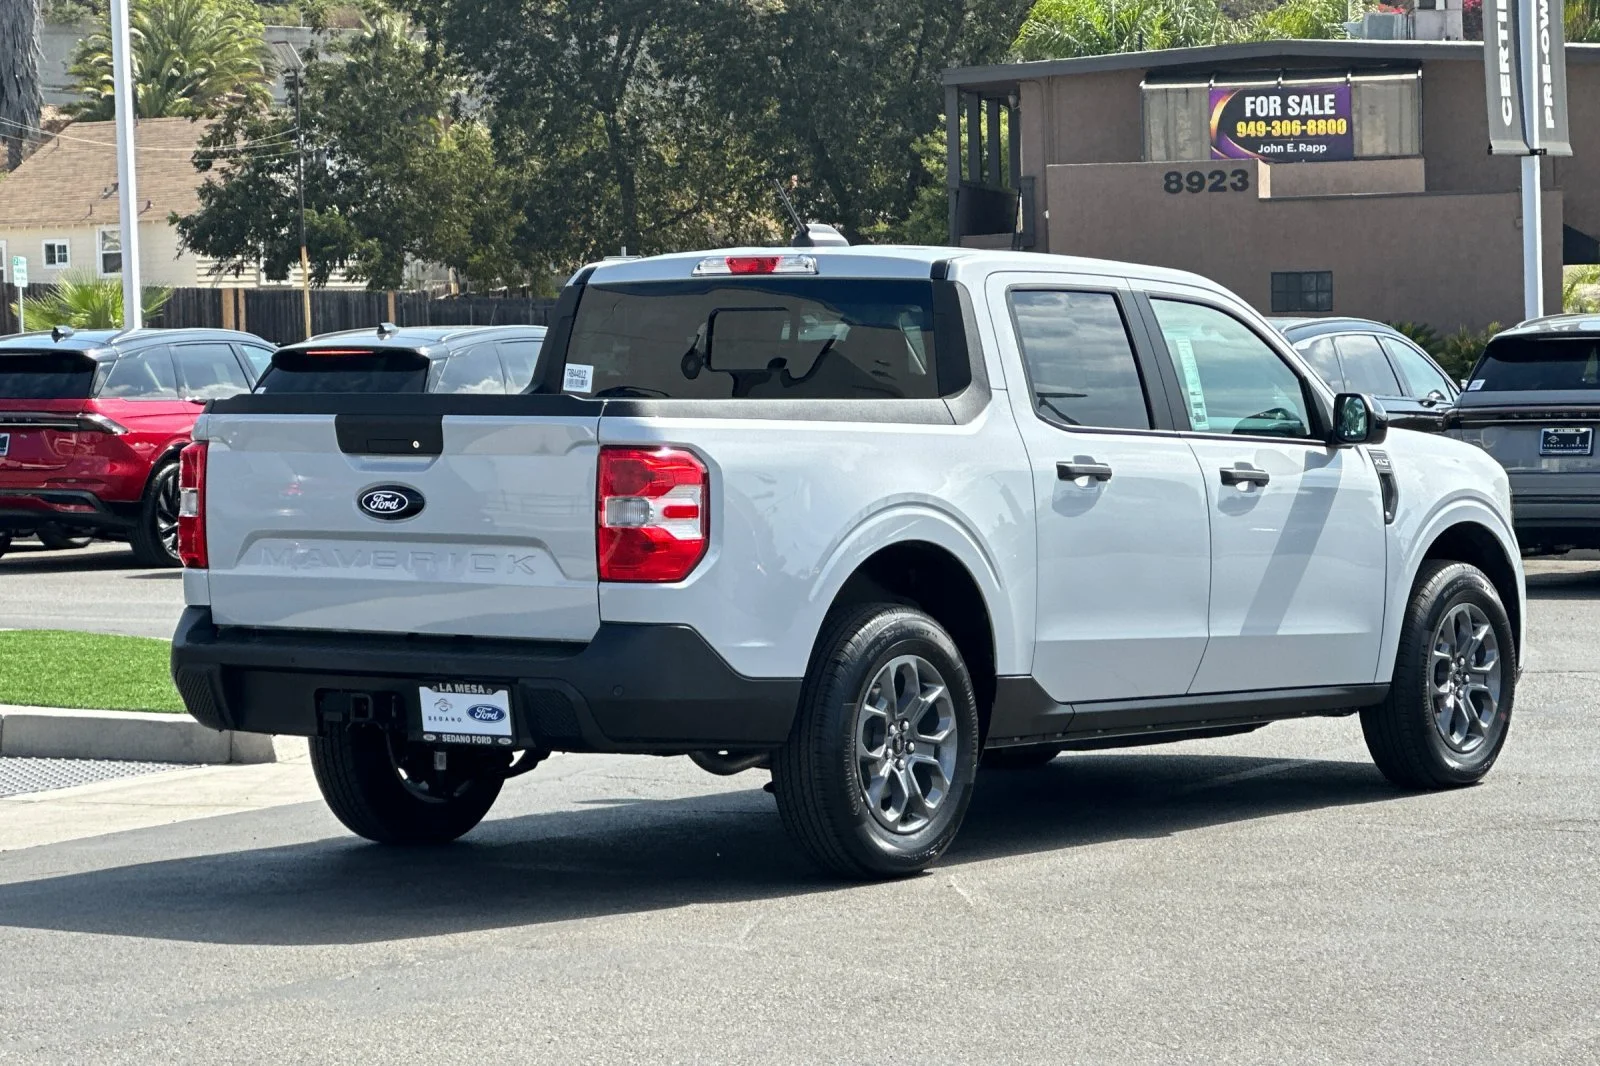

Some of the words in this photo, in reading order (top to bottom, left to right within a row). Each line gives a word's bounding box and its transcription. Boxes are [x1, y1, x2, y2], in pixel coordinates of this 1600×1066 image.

[1244, 96, 1281, 117] FOR
[1287, 94, 1336, 115] SALE
[1236, 118, 1347, 138] 949-306-8800
[1257, 144, 1284, 154] John
[1287, 143, 1297, 153] E.
[1299, 143, 1327, 155] Rapp
[1163, 168, 1250, 195] 8923
[370, 493, 400, 510] Ford
[260, 547, 536, 576] MAVERICK
[439, 683, 453, 693] LA
[455, 684, 485, 694] MESA
[442, 734, 471, 744] SEDANO
[472, 735, 492, 745] FORD
